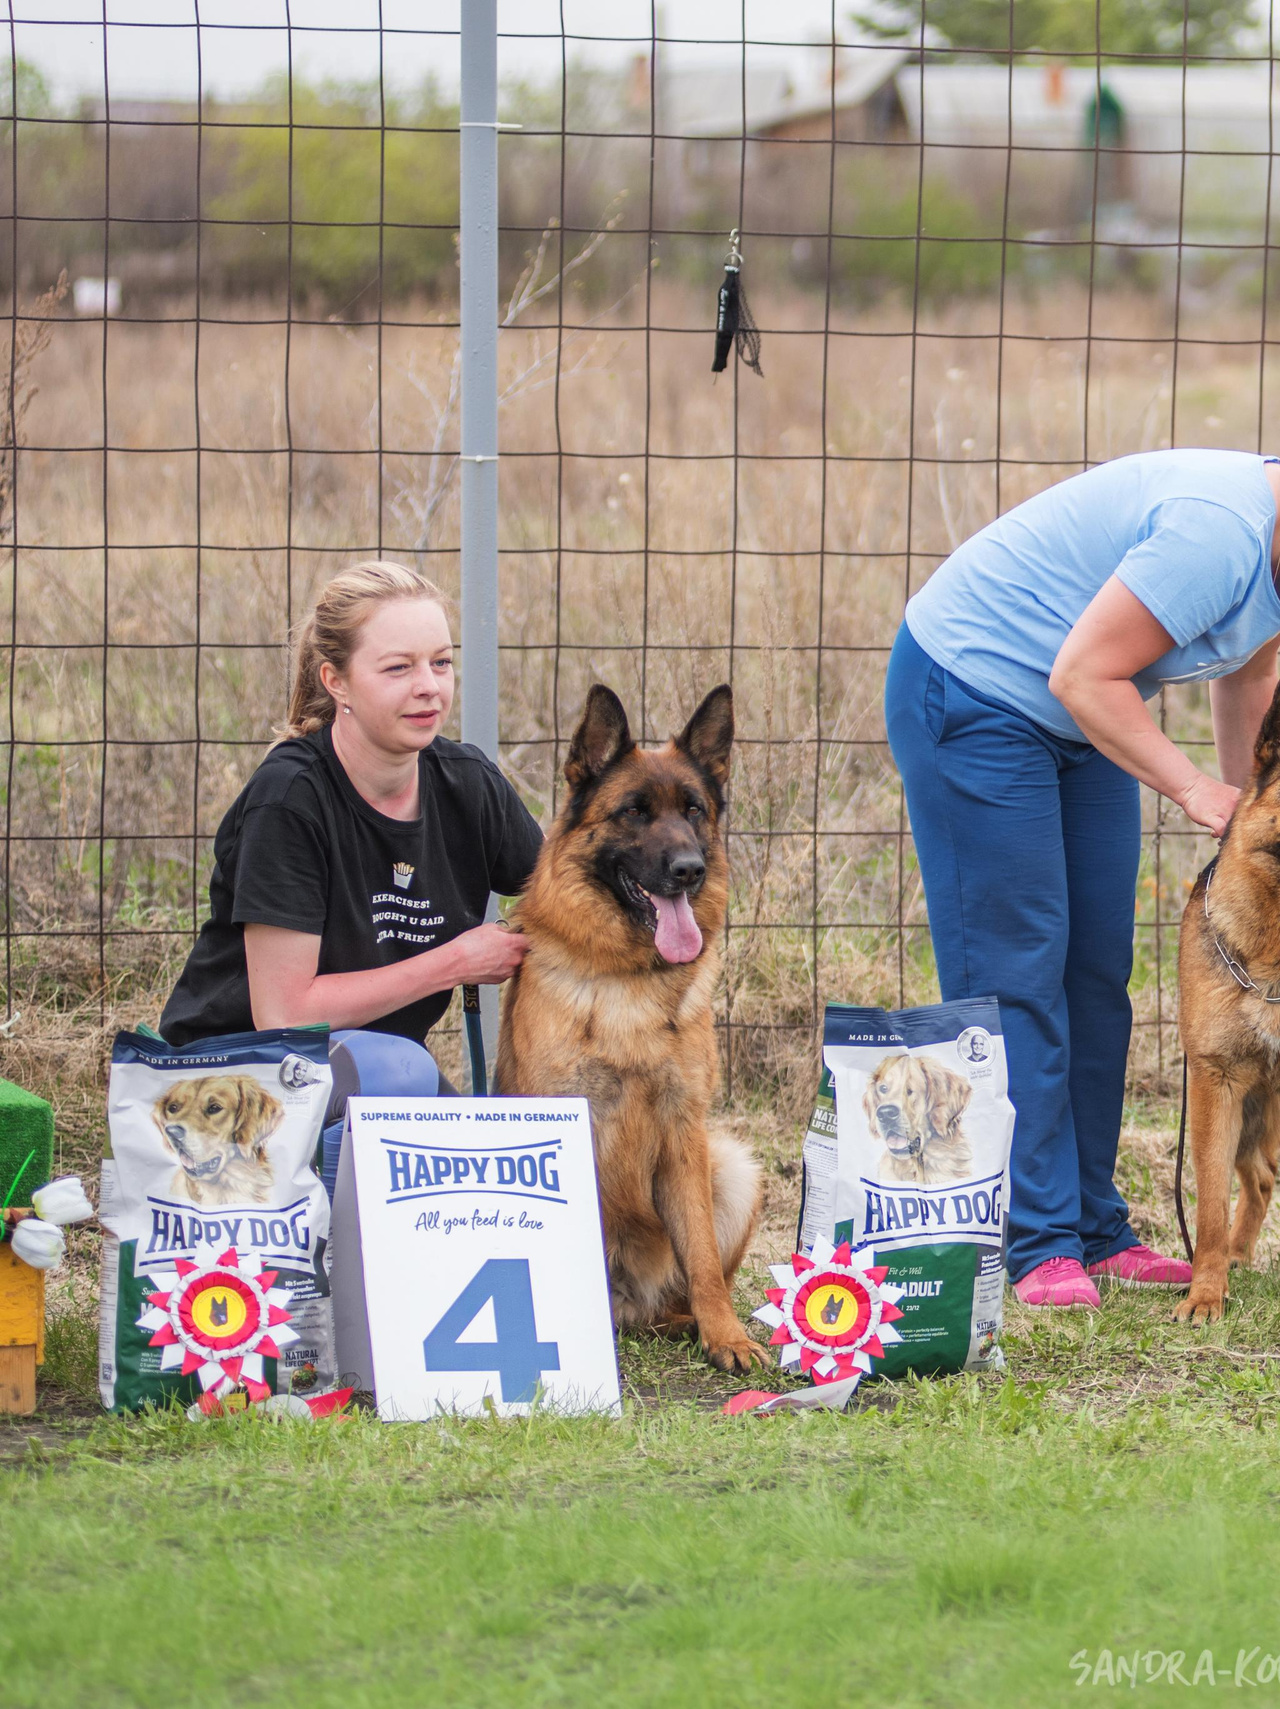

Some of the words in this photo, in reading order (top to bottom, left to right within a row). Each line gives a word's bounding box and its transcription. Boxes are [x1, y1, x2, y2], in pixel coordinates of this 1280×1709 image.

[408, 917, 418, 925] U
[420, 916, 445, 926] SAID
[182, 1055, 229, 1065] GERMANY
[360, 1112, 412, 1121] SUPREME
[414, 1112, 462, 1122] QUALITY
[475, 1113, 507, 1122] MADE
[509, 1113, 521, 1122] IN
[524, 1113, 579, 1122] GERMANY
[386, 1149, 490, 1192] HAPPY
[494, 1151, 560, 1192] DOG
[862, 1189, 947, 1235] HAPPY
[951, 1183, 1002, 1226] DOG
[145, 1208, 243, 1254] HAPPY
[248, 1209, 310, 1251] DOG
[415, 1211, 440, 1231] All
[443, 1215, 468, 1235] you
[471, 1209, 500, 1230] feed
[503, 1215, 514, 1227] is
[518, 1211, 544, 1230] love
[888, 1267, 899, 1275] Fit
[899, 1267, 908, 1276] &
[908, 1267, 923, 1275] Well
[423, 1259, 561, 1403] 4
[285, 1349, 319, 1361] NATURAL
